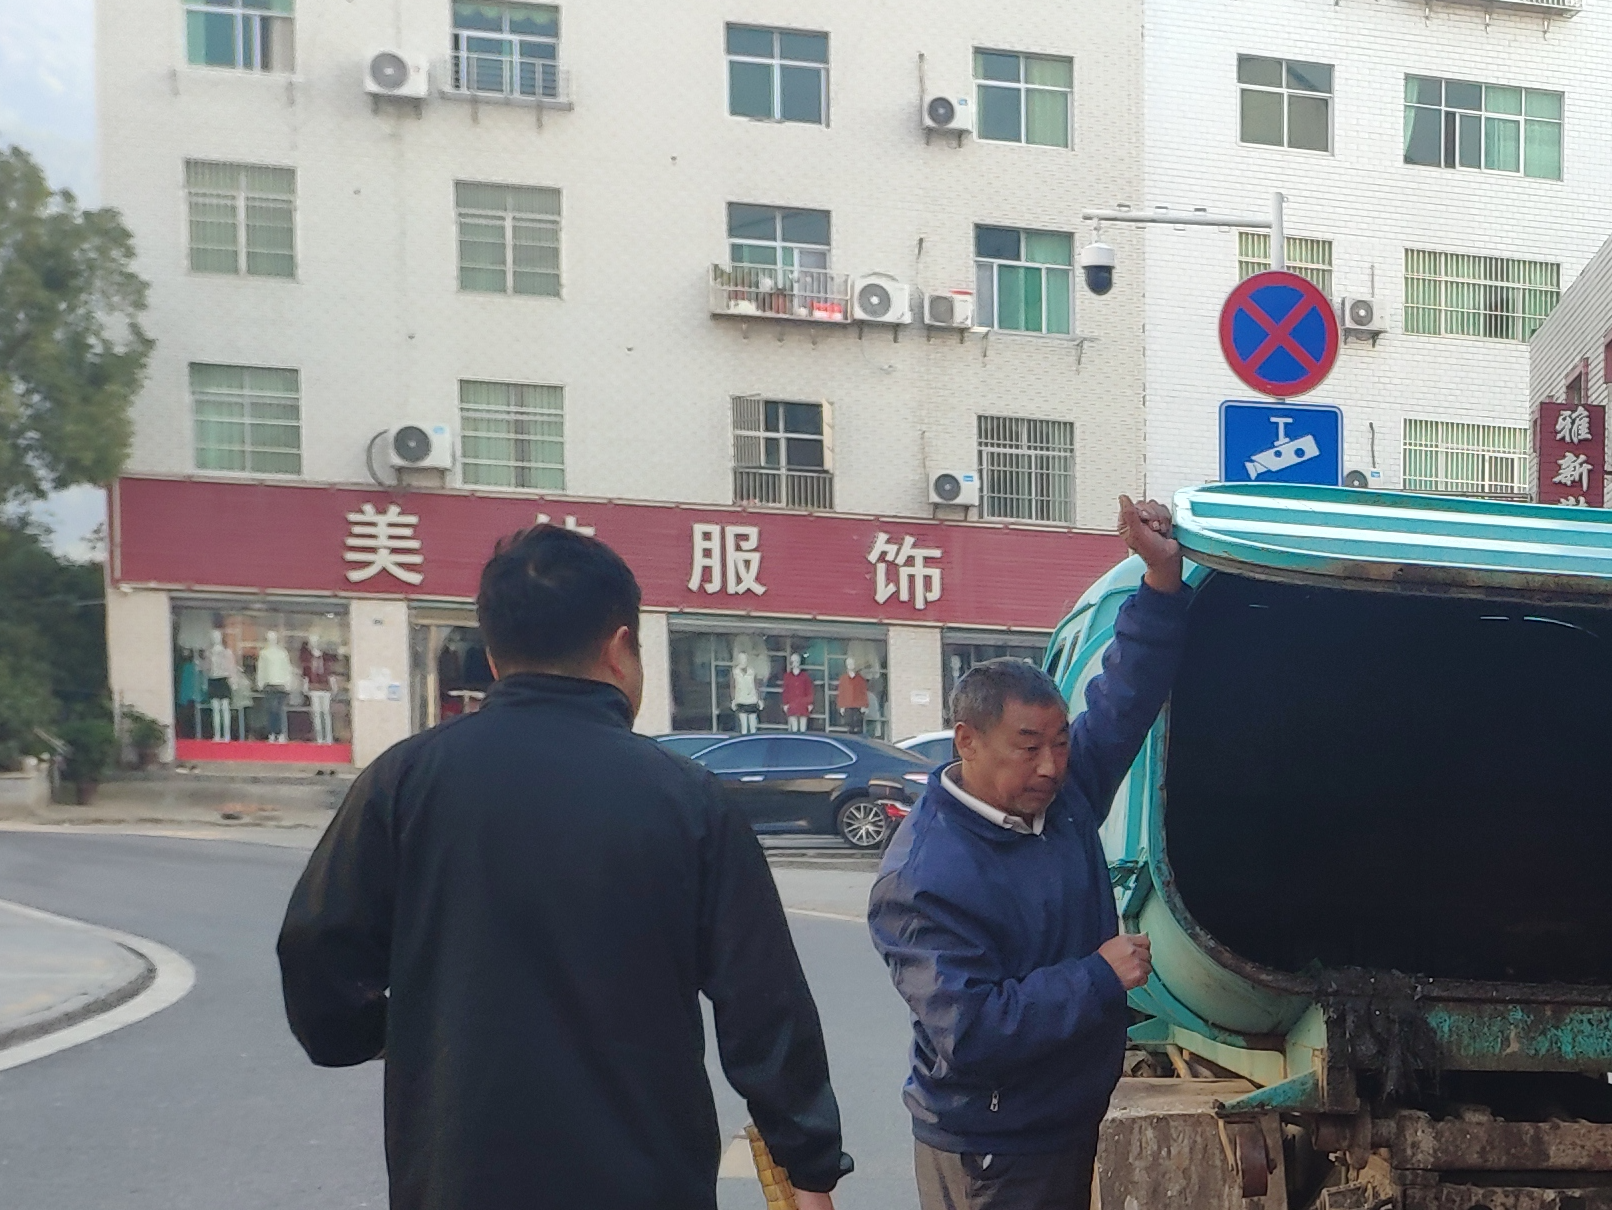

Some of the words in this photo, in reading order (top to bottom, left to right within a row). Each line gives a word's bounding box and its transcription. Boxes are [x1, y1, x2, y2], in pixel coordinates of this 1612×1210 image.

[1551, 406, 1595, 506] 雅新
[343, 502, 944, 611] 美服饰
